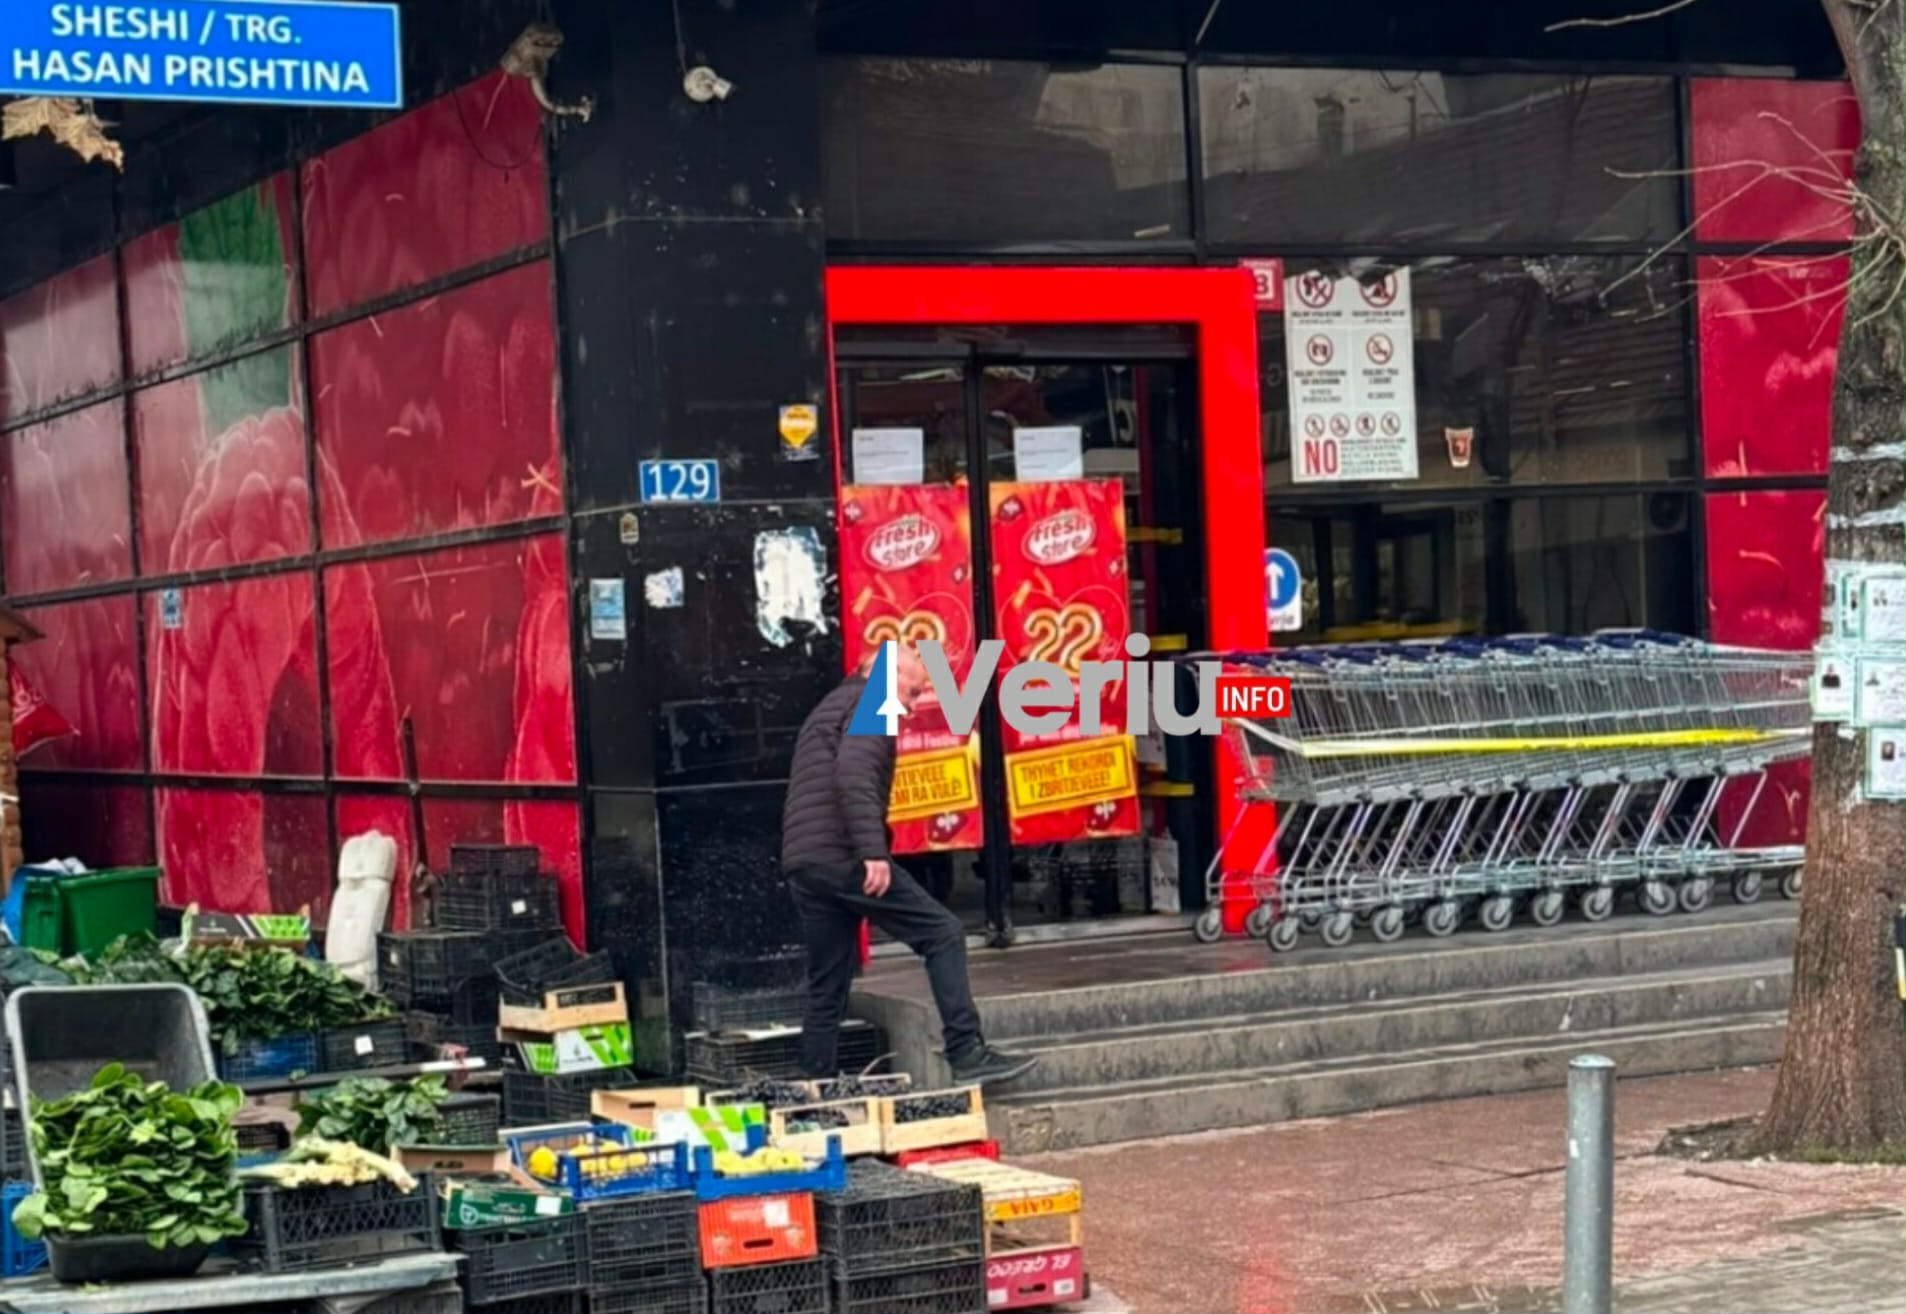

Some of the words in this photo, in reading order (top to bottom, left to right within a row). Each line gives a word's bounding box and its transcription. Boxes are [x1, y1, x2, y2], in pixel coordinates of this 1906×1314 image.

[51, 3, 189, 41] SHESHI
[198, 10, 215, 45] /
[224, 14, 302, 44] TRG.
[12, 48, 151, 85] HASAN
[165, 54, 370, 93] PRISHTINA
[1304, 439, 1338, 475] NO
[648, 463, 710, 501] 129
[1024, 604, 1101, 682] 22
